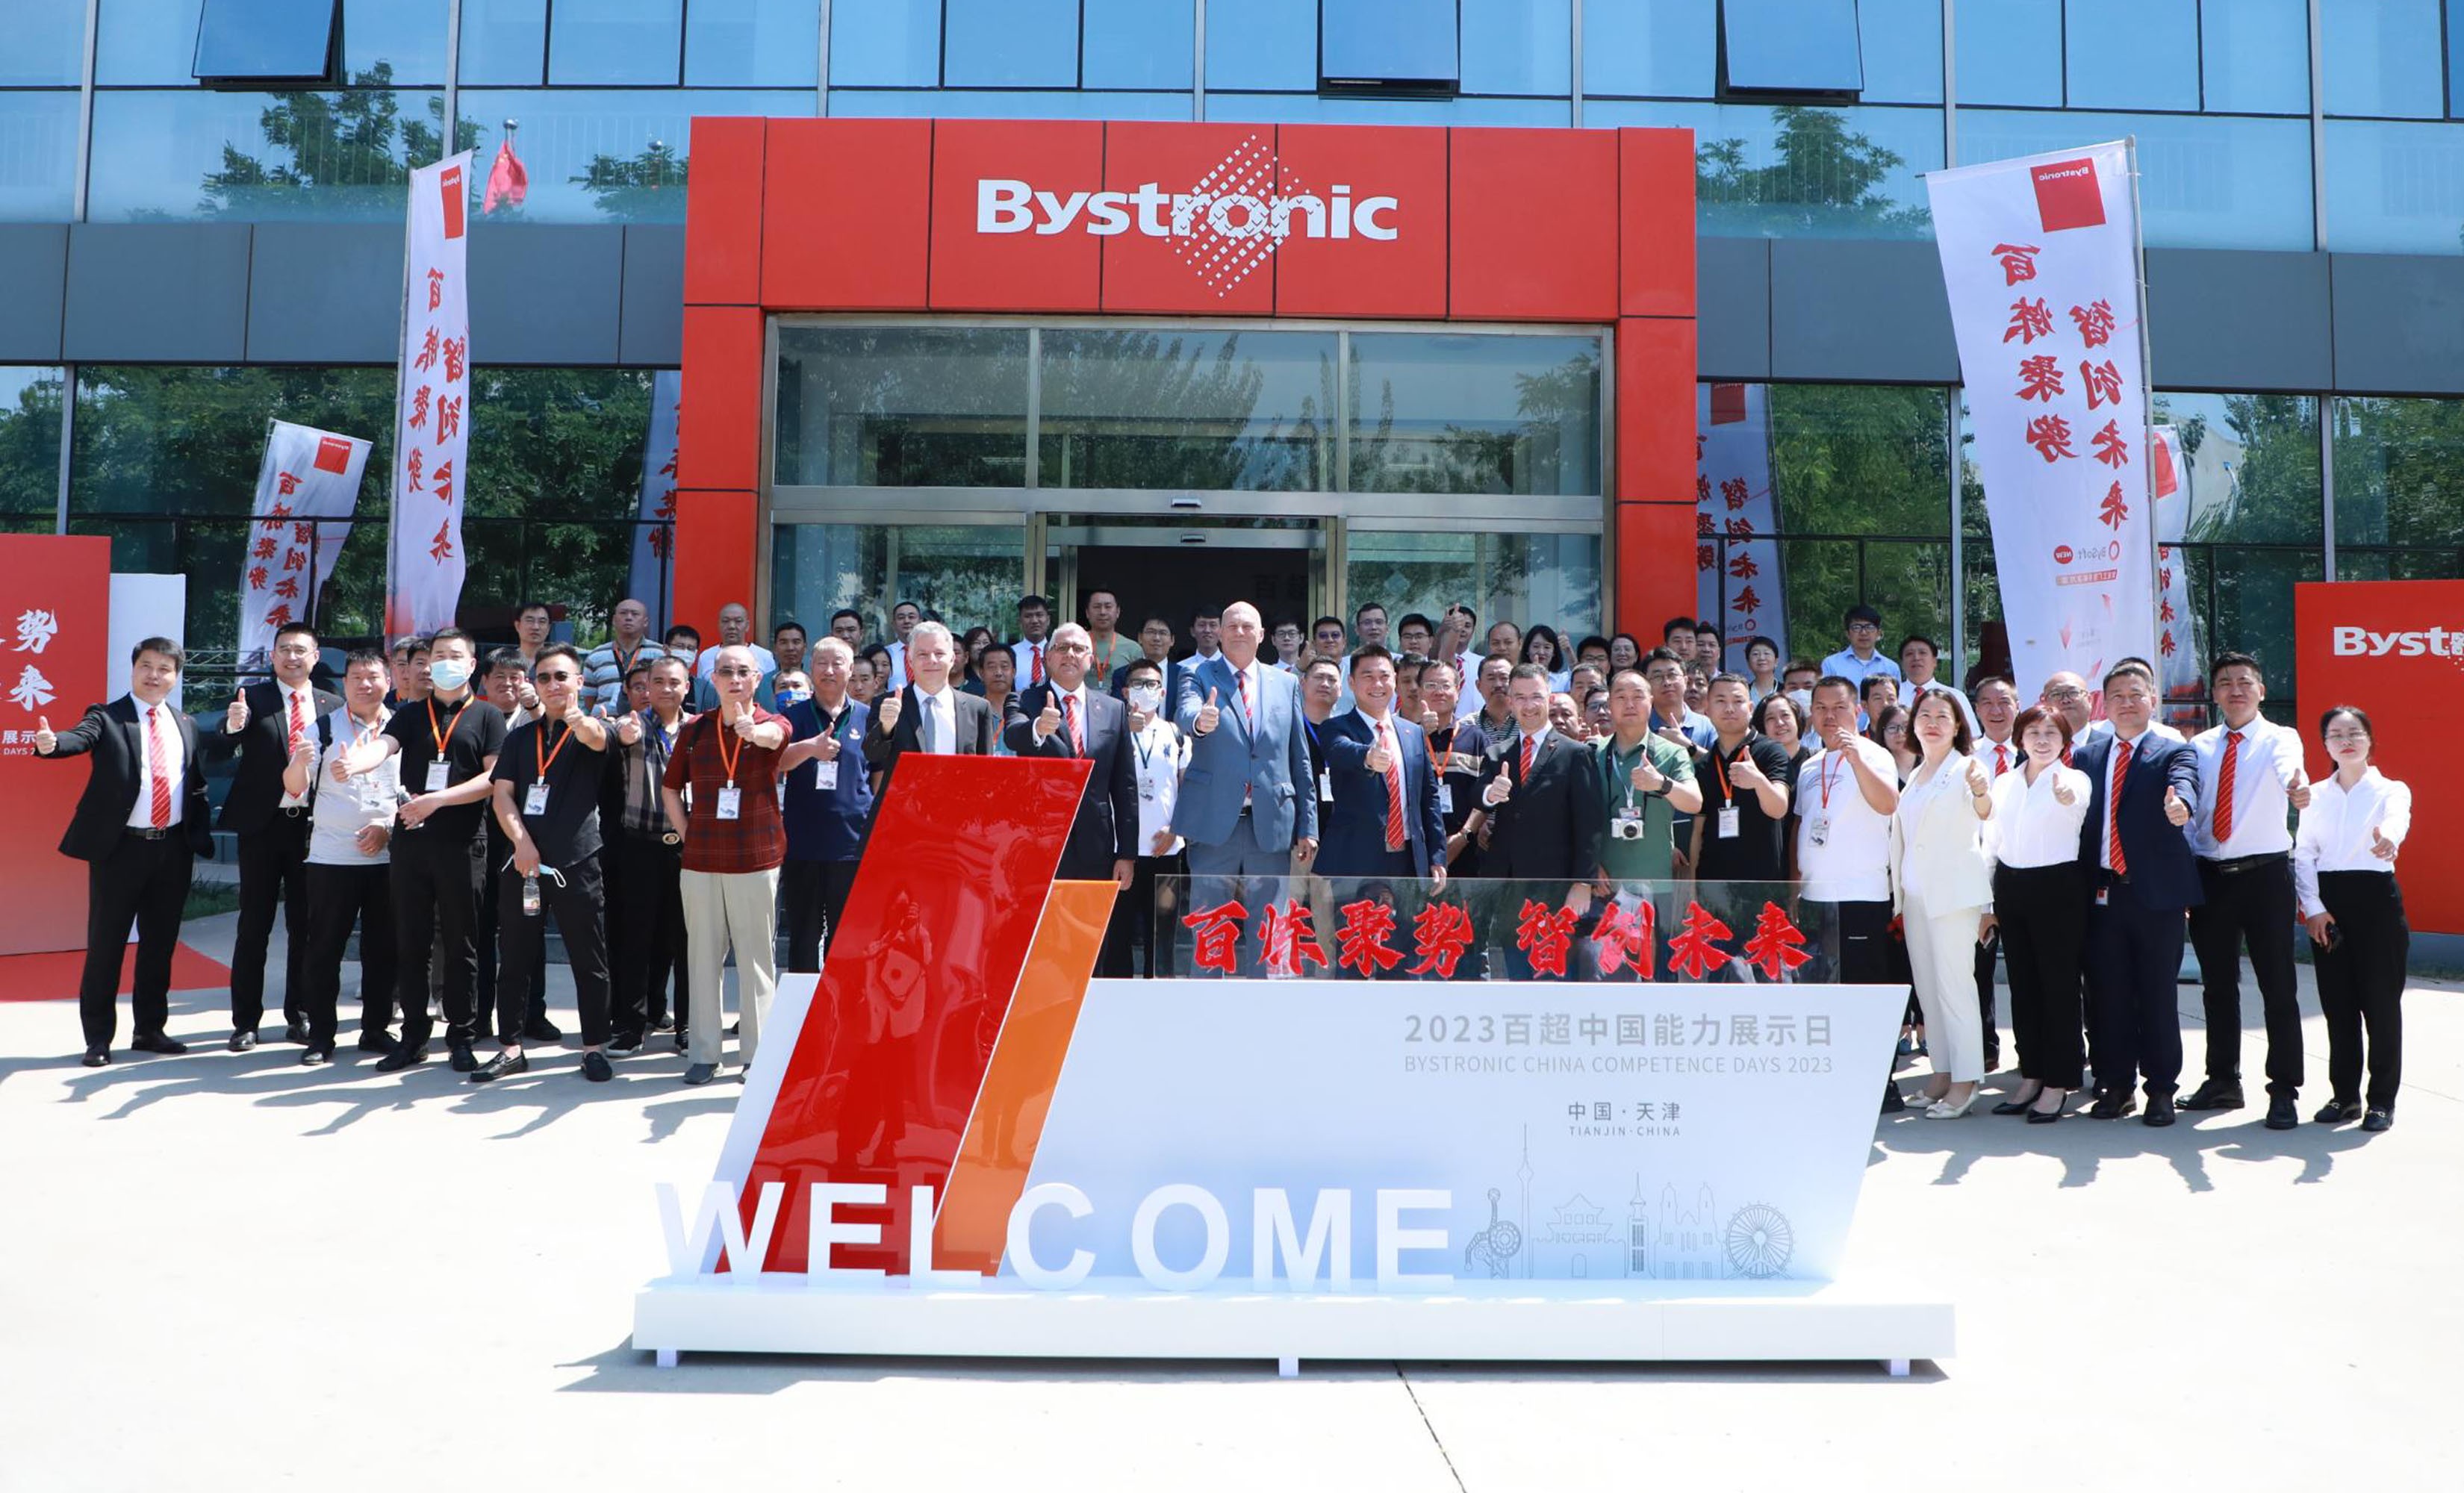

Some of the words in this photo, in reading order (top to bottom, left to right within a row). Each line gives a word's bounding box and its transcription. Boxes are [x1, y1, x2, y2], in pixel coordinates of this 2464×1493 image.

[977, 178, 1399, 241] Bystronic
[0, 609, 58, 655] 势
[0, 664, 57, 711] 来
[1516, 898, 1814, 980] 智创未来
[1404, 1012, 1832, 1047] 2023百超中国能力展示日
[1404, 1056, 1516, 1073] BYSTRONIC
[1523, 1056, 1586, 1073] CHINA
[1592, 1056, 1726, 1073] COMPETENCE
[1734, 1056, 1782, 1073] DAYS
[1788, 1056, 1833, 1073] 2023
[655, 1182, 1455, 1293] WELCOME
